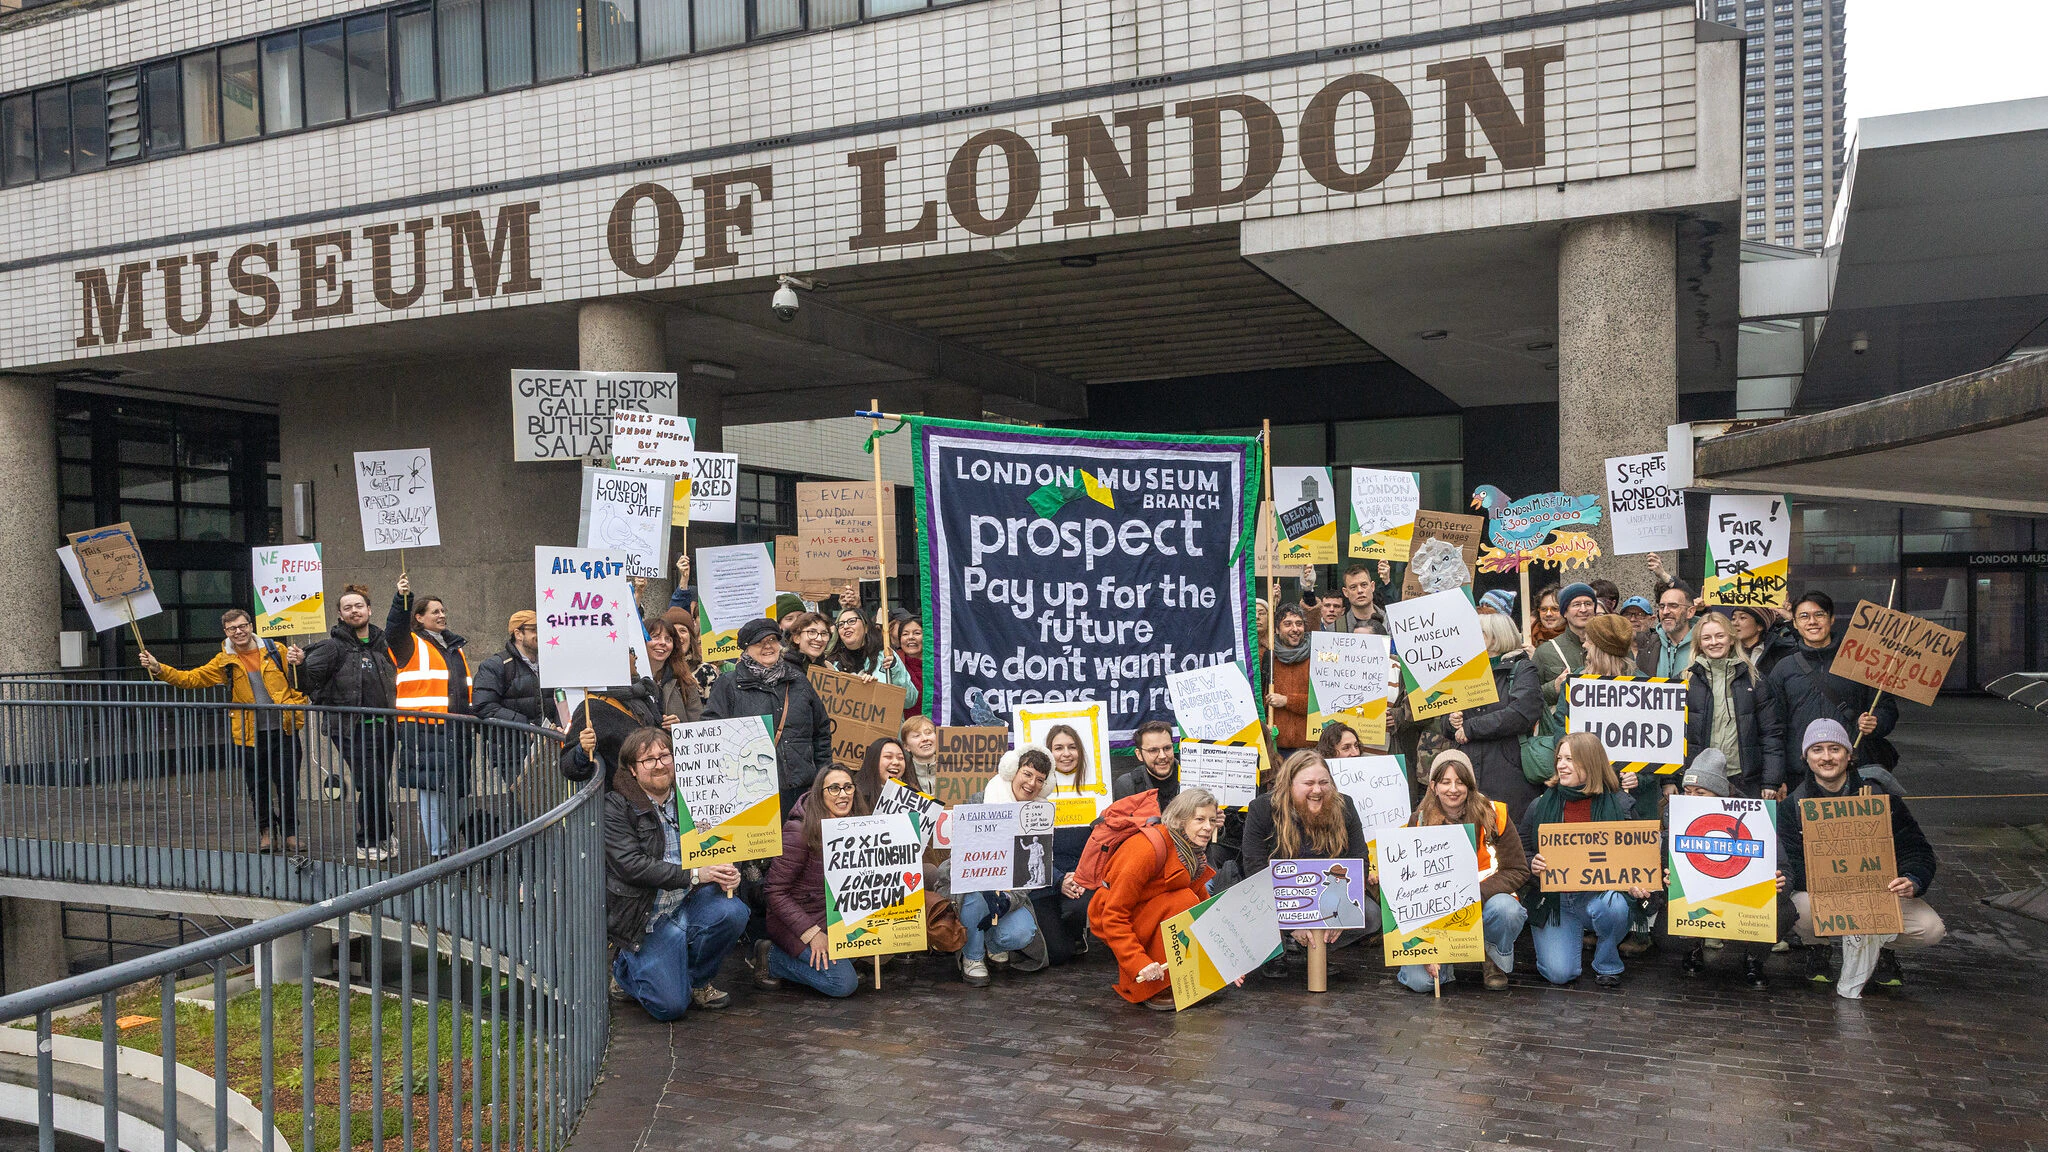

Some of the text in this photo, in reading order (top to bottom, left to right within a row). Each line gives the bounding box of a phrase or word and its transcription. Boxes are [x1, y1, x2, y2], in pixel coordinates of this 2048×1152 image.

[75, 44, 1564, 348] MUSEUM OF LONDON
[518, 378, 676, 399] GREAT HISTORY
[616, 412, 675, 426] WORKS FOR
[615, 425, 690, 442] LONDON MUSEUM
[638, 441, 659, 449] BUT
[360, 461, 386, 476] WE
[615, 456, 676, 467] CAN'T AFFORD
[1617, 456, 1666, 484] SECRETS
[956, 456, 1219, 491] LONDON MUSEUM
[1384, 475, 1411, 483] AFFORD
[370, 475, 404, 491] GET
[598, 478, 647, 494] LONDON
[1358, 484, 1410, 496] LONDON
[363, 494, 400, 509] PAID
[596, 490, 647, 504] MUSEUM
[822, 489, 864, 500] EVEN
[1143, 494, 1220, 509] BRANCH
[1611, 485, 1680, 501] LONDON
[627, 504, 662, 517] STAFF
[1282, 501, 1314, 522] BELOW
[1360, 503, 1411, 517] WAGES
[1496, 497, 1572, 519] LONDON MUSEUM
[1612, 496, 1684, 513] MUSEUM:
[378, 506, 432, 526] REALLY
[805, 508, 855, 522] LONDON
[1418, 517, 1473, 531] Conserve
[1719, 513, 1764, 536] FAIR
[375, 527, 428, 545] BADLY
[970, 510, 1203, 570] prospect
[1494, 532, 1544, 551] TRICKLING
[862, 549, 877, 557] PAY
[1354, 545, 1386, 554] prospect
[1546, 538, 1595, 558] DOWN?
[1729, 539, 1772, 557] PAY
[260, 551, 278, 566] WE
[282, 560, 321, 574] REFUSE
[552, 557, 576, 574] ALL
[1969, 554, 2018, 564] LONDON
[1715, 559, 1754, 577] FOR
[964, 566, 1216, 619] Pay up for the
[1737, 575, 1788, 593] HARD
[571, 592, 603, 610] NO
[1719, 591, 1779, 605] WORK
[262, 624, 294, 632] prospect
[1038, 610, 1153, 644] future
[1395, 613, 1435, 634] NEW
[1853, 605, 1961, 657] SHINY NEW
[1333, 638, 1356, 647] NEED
[1414, 626, 1460, 643] MUSEUM
[1405, 645, 1443, 665] OLD
[1879, 637, 1922, 659] MUSEUM
[953, 644, 1176, 682] we don't want
[1345, 655, 1384, 665] MUSEUM?
[1427, 656, 1464, 673] WAGES
[1840, 639, 1942, 688] RUSTY OLD
[1315, 667, 1383, 681] WE NEED MORE
[1865, 667, 1908, 690] WAGES
[811, 672, 850, 697] NEW
[1176, 673, 1215, 697] NEW
[1110, 680, 1141, 714] in
[1180, 689, 1232, 710] MUSEUM
[1418, 696, 1458, 713] prospect
[1570, 684, 1686, 711] CHEAPSKATE
[822, 695, 886, 723] MUSEUM
[1203, 702, 1235, 721] OLD
[673, 726, 722, 740] OUR WAGES
[1189, 715, 1245, 740] WAGES
[1585, 722, 1672, 749] HOARD
[674, 743, 721, 757] ARE STUCK
[938, 730, 1008, 754] LONDON
[676, 759, 719, 772] DOWN IN
[678, 775, 725, 788] THE SEWER
[1340, 771, 1365, 786] OUR
[686, 789, 719, 802] LIKE A
[894, 787, 933, 814] NEW
[690, 804, 736, 817] FATBERG!
[1358, 797, 1374, 812] NO
[1721, 800, 1762, 811] WAGES
[1803, 798, 1885, 821] BEHIND
[967, 810, 1012, 821] FAIR WAGE
[837, 819, 888, 830] STATUS:
[984, 824, 997, 832] MY
[1816, 821, 1880, 839] EVERY
[827, 832, 892, 852] TOXIC
[1541, 831, 1658, 846] DIRECTOR'S BONUS
[1680, 839, 1759, 855] MIND THE GAP
[689, 845, 736, 860] prospect
[1386, 838, 1450, 863] We Preserve
[1811, 839, 1889, 856] EXHIBIT
[828, 843, 921, 872] RELATIONSHIP
[964, 851, 1007, 862] ROMAN
[1832, 856, 1881, 873] IS AN
[961, 867, 1007, 878] EMPIRE
[1276, 865, 1295, 874] FAIR
[1401, 855, 1454, 881] the PAST
[1546, 868, 1657, 885] MY SALARY
[840, 872, 901, 891] LONDON
[833, 886, 905, 912] MUSEUM
[1275, 888, 1317, 896] BELONGS
[1396, 880, 1451, 901] Respect our
[1398, 892, 1456, 921] FUTURES!
[1815, 893, 1894, 913] MUSEUM
[1279, 912, 1319, 920] MUSEUM!
[1676, 918, 1726, 929] prospect
[1816, 914, 1897, 933] WORKER
[836, 937, 882, 952] prospect
[1168, 923, 1184, 966] prospect
[1208, 927, 1238, 968] WORKERS
[1392, 947, 1438, 958] prospect
